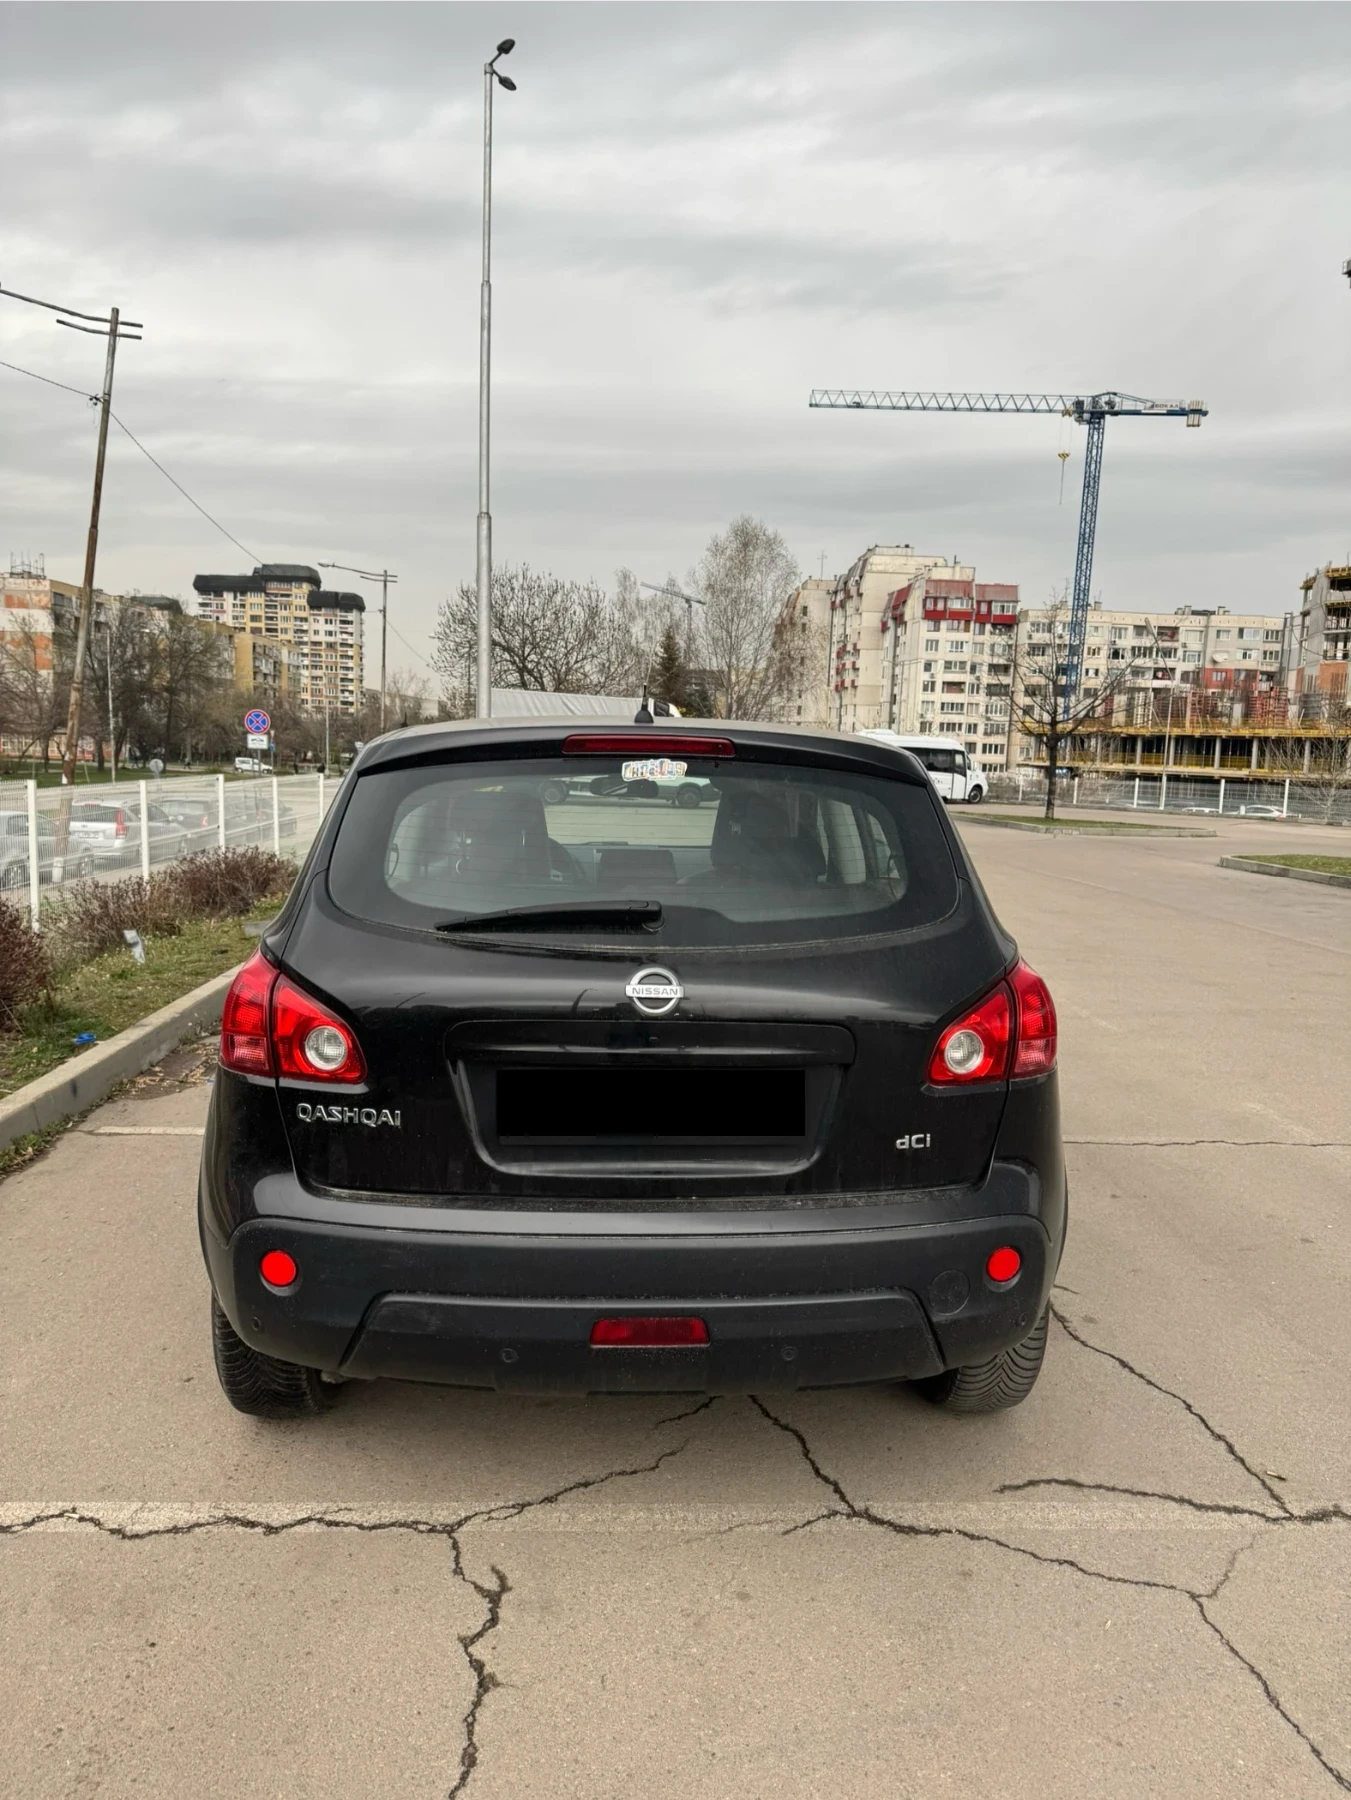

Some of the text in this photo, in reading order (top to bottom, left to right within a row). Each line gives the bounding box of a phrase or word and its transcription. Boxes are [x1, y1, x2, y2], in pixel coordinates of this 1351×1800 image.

[632, 987, 678, 996] NISSAN
[296, 1103, 401, 1127] QASHQAI
[896, 1133, 931, 1149] dCi
